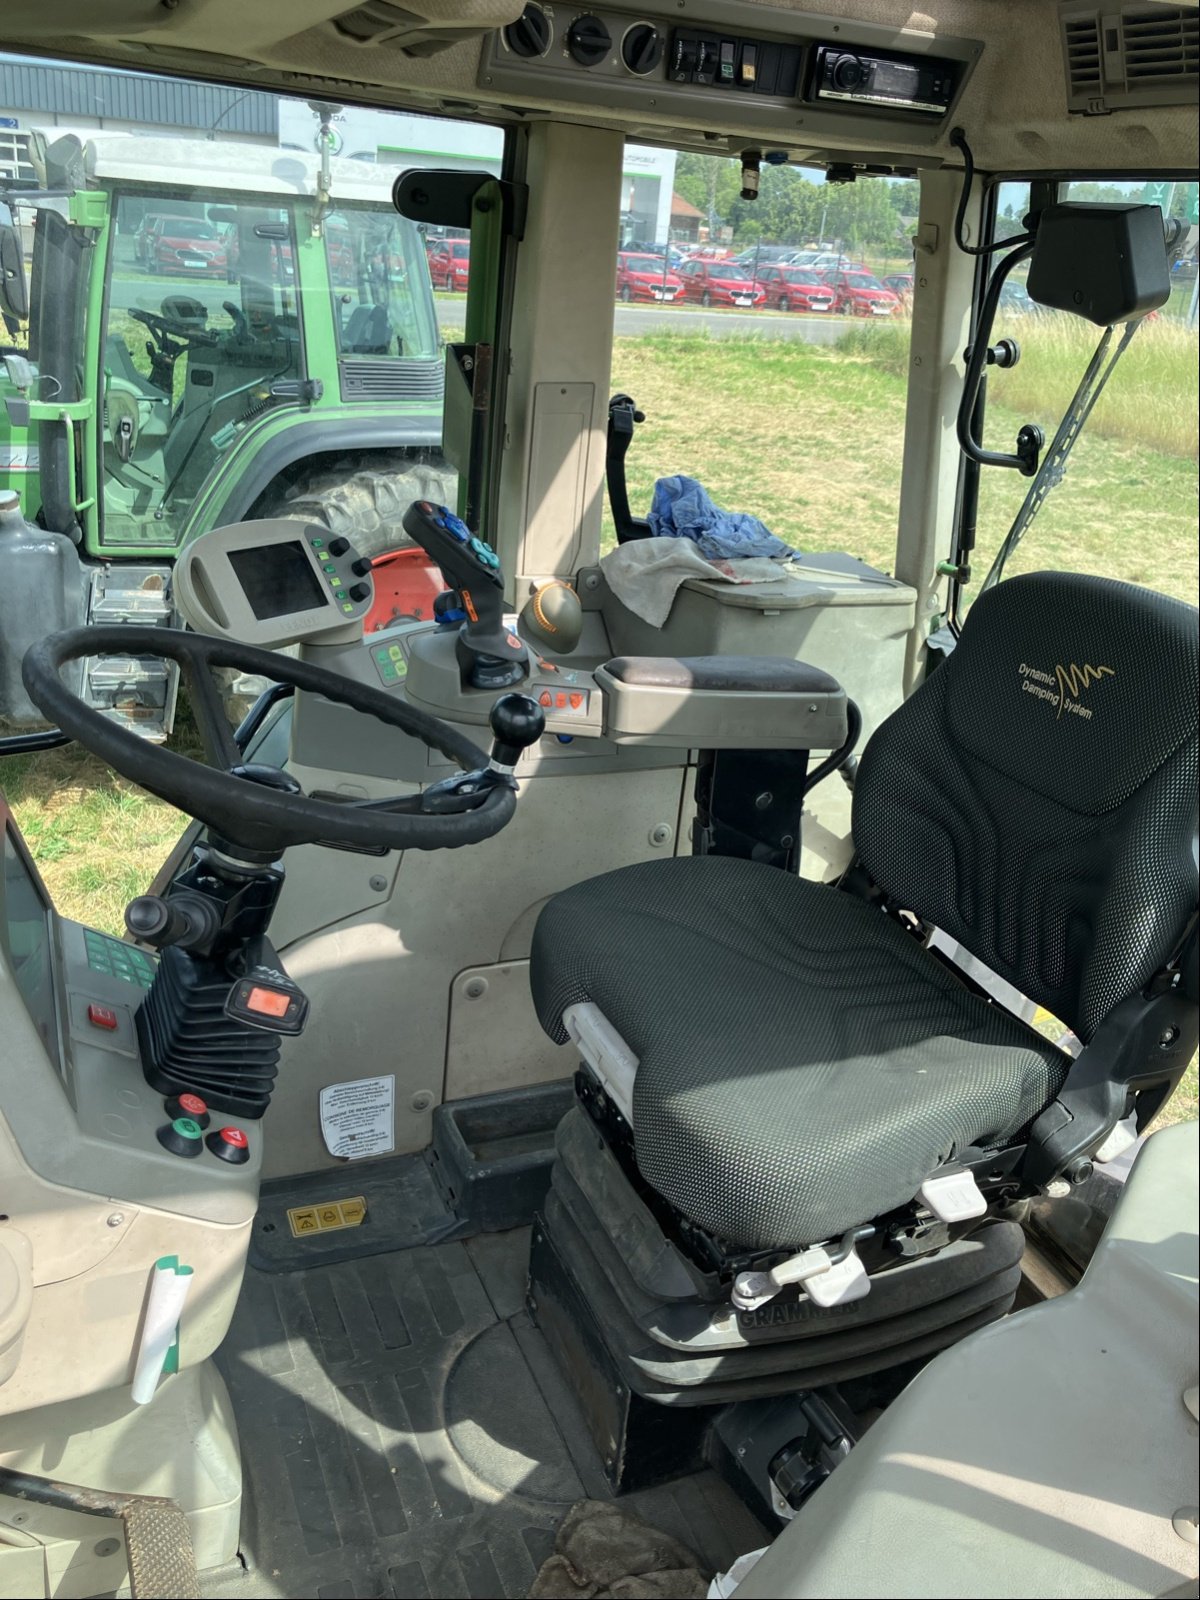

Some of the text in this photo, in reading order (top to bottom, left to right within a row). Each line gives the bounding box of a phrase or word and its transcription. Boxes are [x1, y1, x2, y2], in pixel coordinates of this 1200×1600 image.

[312, 111, 347, 122] SDA
[1018, 663, 1056, 686] Dynamic
[1022, 680, 1092, 719] Damping System
